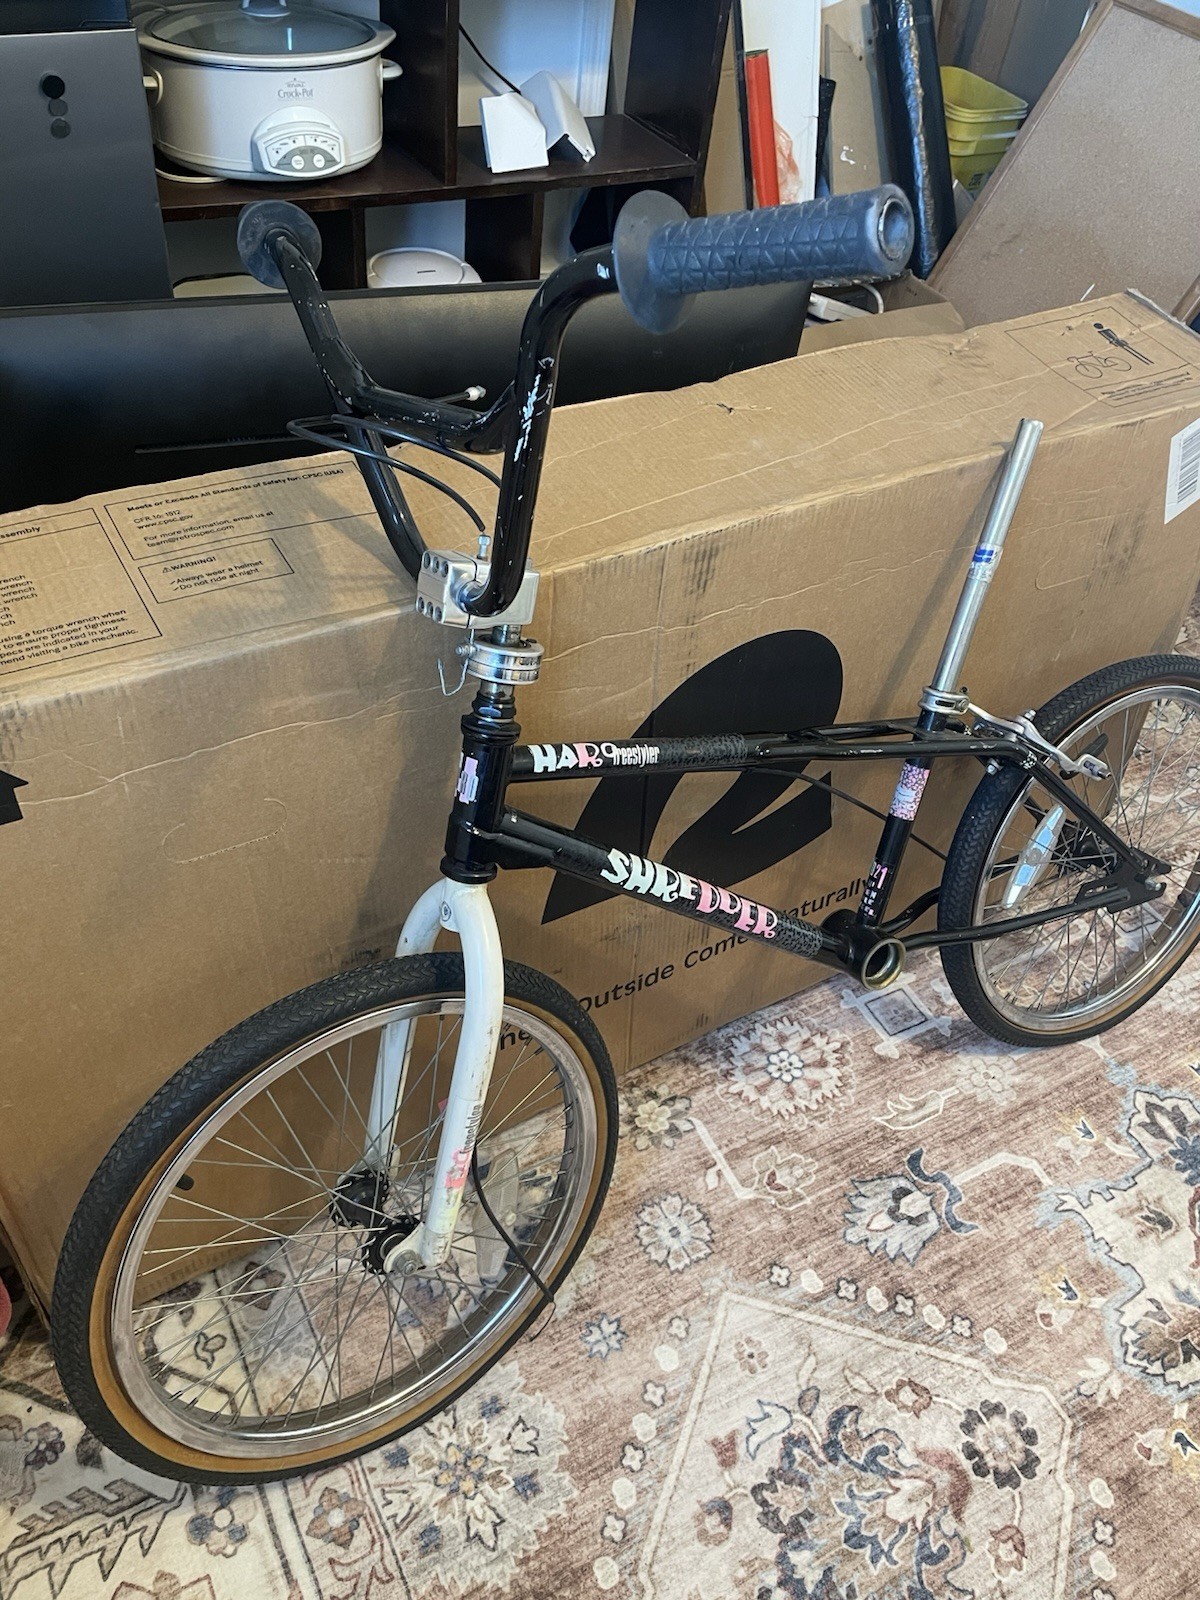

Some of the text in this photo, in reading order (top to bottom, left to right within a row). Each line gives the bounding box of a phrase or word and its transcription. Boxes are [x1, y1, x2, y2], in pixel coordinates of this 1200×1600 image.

[127, 503, 153, 511] Meets
[165, 494, 199, 504] Exceeds
[212, 484, 251, 495] Standards
[262, 478, 286, 486] Safety
[302, 472, 323, 480] CPSC
[325, 468, 344, 476] (USA)
[133, 515, 152, 524] CFR
[165, 509, 181, 517] 1512
[137, 514, 194, 530] www.cpsc.gov
[160, 530, 182, 538] more
[182, 519, 232, 532] information,
[233, 514, 253, 522] email
[0, 526, 41, 539] ssembly
[146, 525, 235, 547] team@retrospec.com
[170, 556, 217, 571] WARNING!
[176, 574, 204, 584] Always
[205, 568, 226, 577] wear
[234, 560, 264, 570] helmet
[0, 574, 26, 584] rench
[193, 579, 209, 587] not
[210, 575, 227, 583] ride
[239, 568, 260, 577] night
[1, 586, 36, 598] wrench
[4, 592, 38, 604] wrench
[16, 635, 49, 647] ensure
[51, 627, 83, 639] proper
[84, 616, 128, 631] tightness.
[32, 624, 64, 635] torque
[65, 615, 100, 627] wrench
[101, 609, 127, 618] when
[0, 649, 23, 660] pecs
[25, 644, 41, 652] are
[42, 632, 87, 648] indicated
[98, 625, 120, 635] your
[27, 647, 61, 659] visiting
[70, 639, 90, 649] bike
[91, 630, 139, 643] mechanic.
[527, 742, 616, 773] HARO
[600, 848, 778, 939] SHREDDER
[684, 933, 749, 969] Come
[784, 878, 867, 918] aturall
